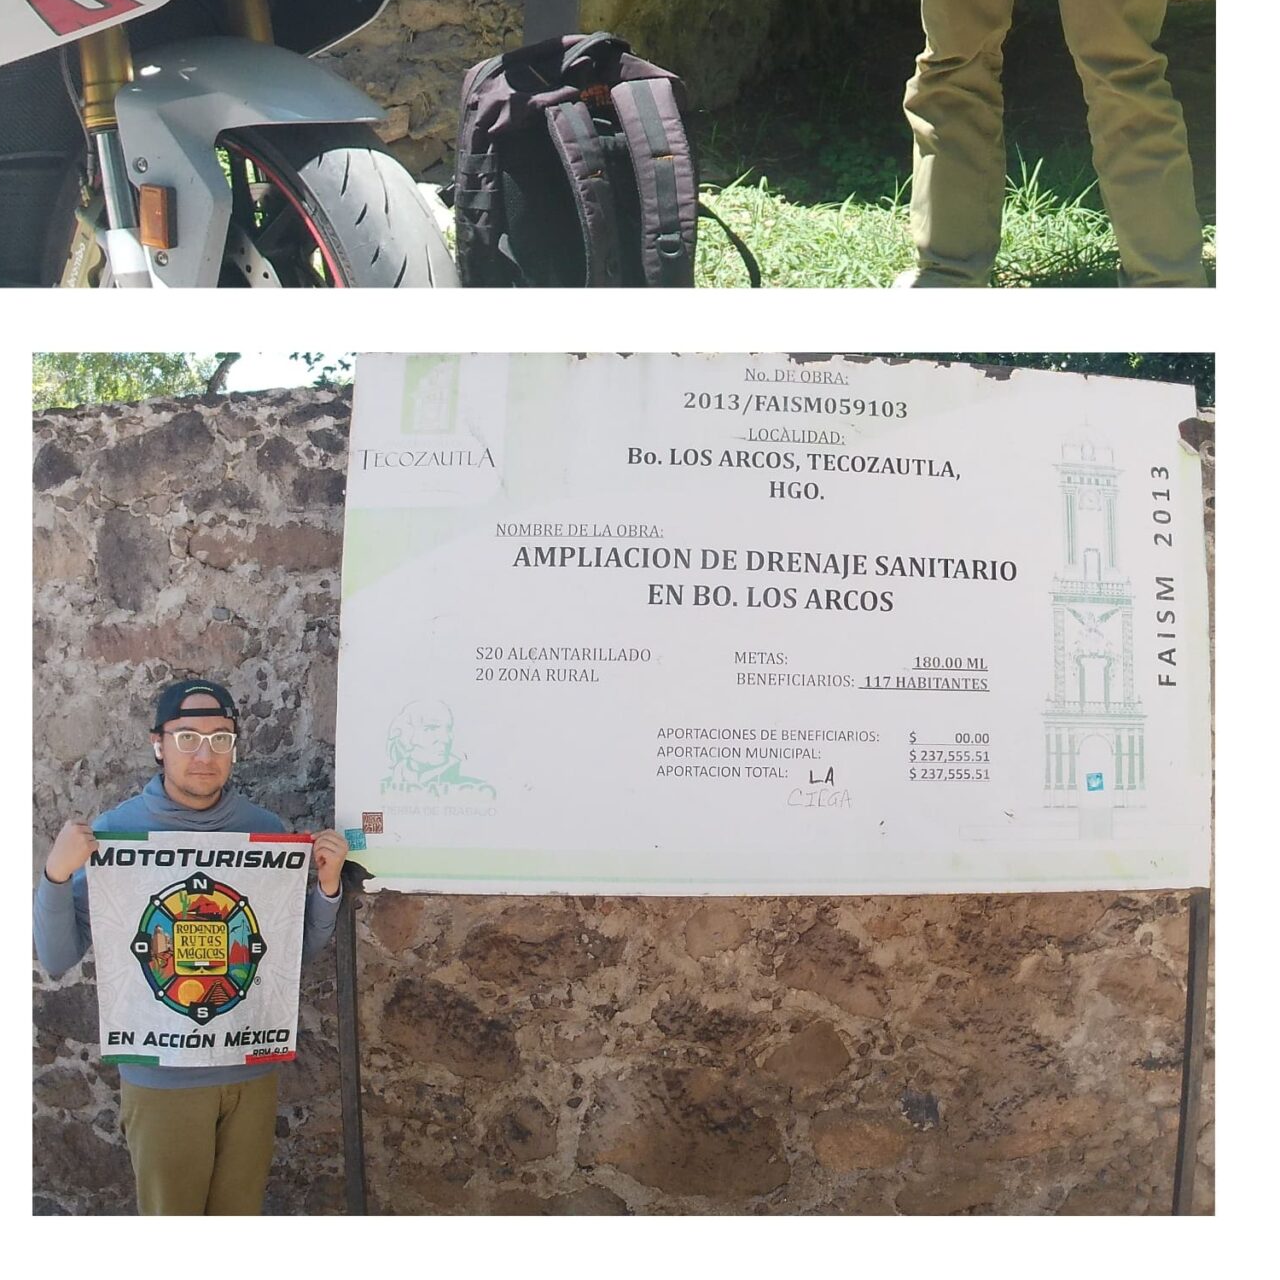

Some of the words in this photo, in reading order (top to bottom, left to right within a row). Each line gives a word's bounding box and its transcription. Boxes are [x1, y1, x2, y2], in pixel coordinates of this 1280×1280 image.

[745, 368, 769, 381] No.
[775, 369, 796, 382] DE
[800, 370, 848, 385] OBRA:
[684, 391, 908, 418] 2013/FAISM059103
[358, 447, 495, 470] TECOZAUTLA
[627, 447, 662, 466] Bo.
[669, 448, 712, 467] LOS
[718, 449, 801, 472] ARCOS,
[807, 452, 962, 480] TECOZAUTLA,
[768, 480, 825, 501] HGO.
[1151, 466, 1173, 547] 2013
[496, 522, 563, 537] NOMBRE
[568, 523, 588, 537] DE
[592, 524, 613, 537] LA
[617, 524, 664, 539] OBRA:
[511, 545, 692, 570] AMPLIACION
[700, 548, 738, 571] DE
[745, 551, 868, 577] DRENAJE
[874, 554, 1019, 582] SANITARIO
[647, 583, 684, 606] EN
[692, 585, 739, 608] BO.
[746, 587, 798, 610] LOS
[803, 588, 895, 613] ARCOS
[1155, 575, 1177, 687] FAISM
[475, 646, 504, 661] S20
[507, 647, 652, 662] ALCANTARILLADO
[734, 651, 789, 666] METAS:
[914, 655, 964, 670] 180.00
[966, 657, 988, 670] ML
[475, 668, 495, 682] 20
[498, 668, 542, 682] ZONA
[545, 668, 599, 683] RURAL
[736, 672, 855, 689] BENEFICIARIOS:
[863, 675, 892, 690] 117
[896, 676, 989, 691] HABITANTES
[656, 727, 759, 742] APORTACIONES
[761, 728, 779, 742] DE
[781, 729, 880, 744] BENEFICIARIOS:
[908, 730, 918, 745] $
[954, 731, 990, 745] 00.00
[656, 745, 742, 760] APORTACION
[745, 747, 822, 761] MUNICIPAL:
[908, 749, 918, 763] $
[920, 749, 990, 764] 237,555.51
[656, 765, 742, 779] APORTACION
[745, 766, 789, 780] TOTAL:
[908, 767, 918, 781] $
[920, 767, 990, 782] 237,555.51
[809, 766, 834, 786] LA
[90, 847, 306, 869] MOTOTURISMO
[192, 878, 208, 889] N
[134, 941, 149, 953] O
[251, 943, 262, 953] E
[197, 1007, 209, 1018] S
[107, 1031, 135, 1045] EN
[142, 1029, 216, 1049] ACCIÓN
[224, 1026, 290, 1047] MÉXICO
